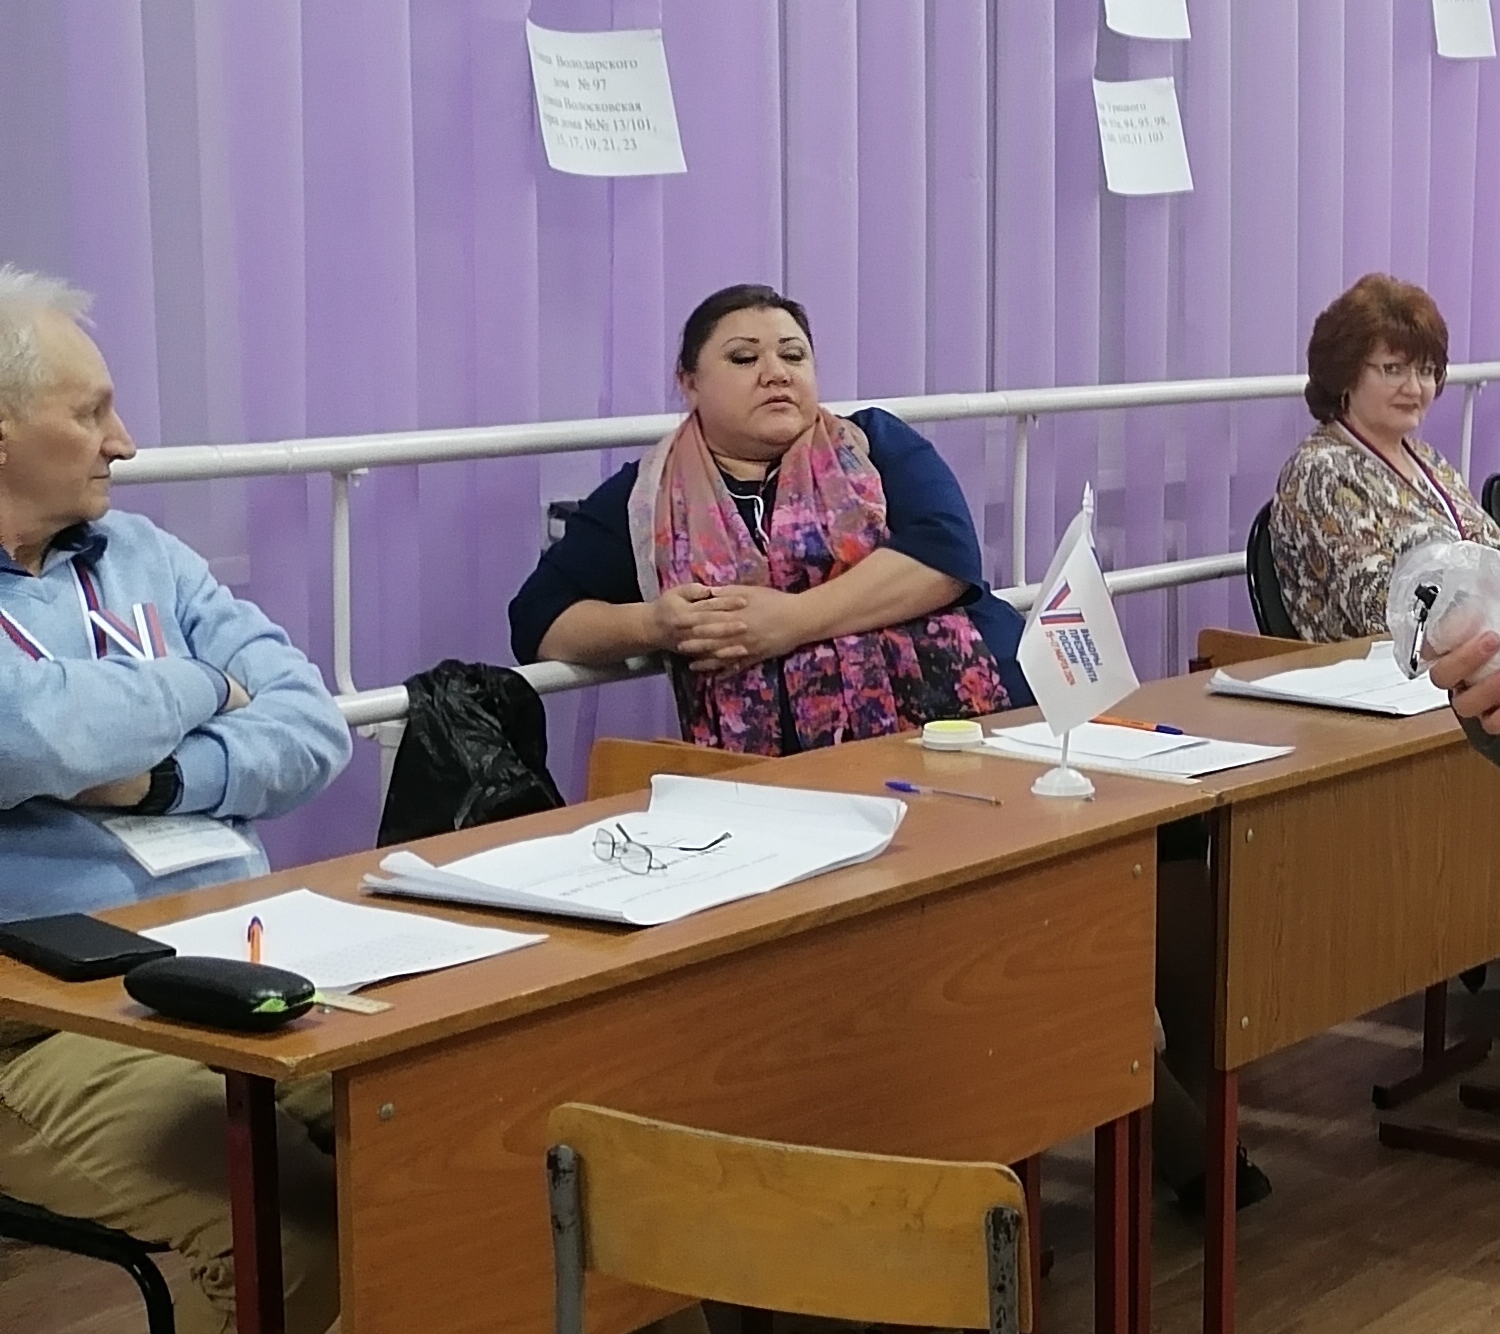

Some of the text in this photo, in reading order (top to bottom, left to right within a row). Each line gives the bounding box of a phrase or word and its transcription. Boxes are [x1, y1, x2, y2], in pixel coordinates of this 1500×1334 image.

[556, 55, 639, 74] Володарского
[592, 78, 607, 91] 97
[1056, 629, 1080, 664] РОССИИ
[1068, 629, 1098, 683] ПРЕЗИДЕНТА
[1080, 628, 1103, 666] ВЫБОРЫ
